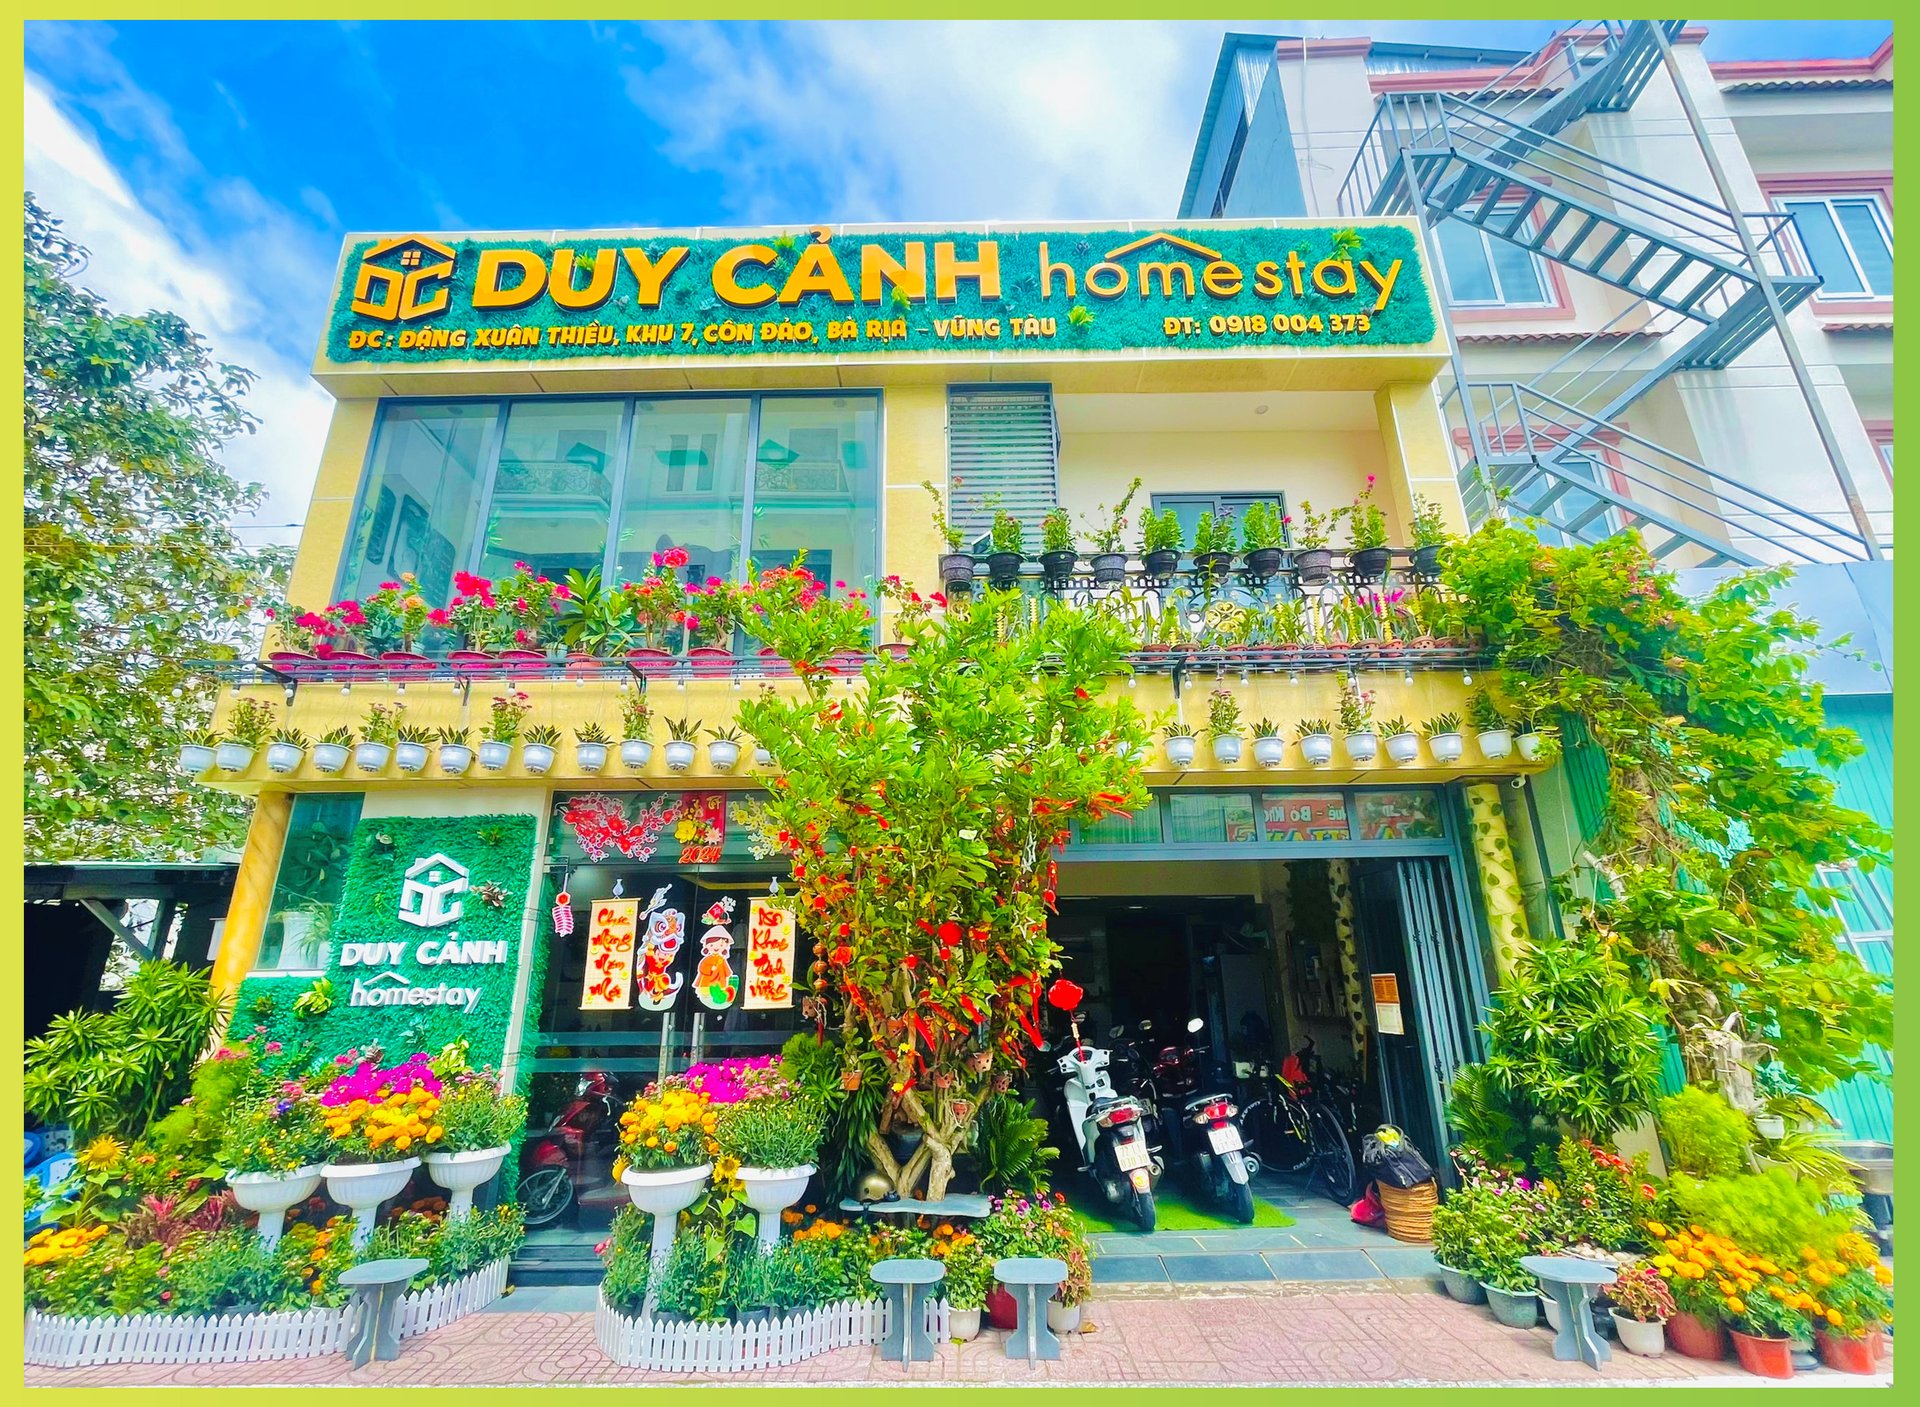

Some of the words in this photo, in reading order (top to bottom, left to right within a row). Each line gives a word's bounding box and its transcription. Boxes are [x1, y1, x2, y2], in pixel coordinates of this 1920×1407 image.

[472, 246, 690, 311] DUY
[712, 227, 1000, 308] CẢNH
[1039, 237, 1403, 313] homestay
[399, 325, 467, 350] ĐẶNG
[473, 323, 540, 348] XUÂN
[547, 318, 620, 347] THIỀU,
[626, 323, 674, 344] KHU
[680, 322, 699, 348] 7,
[703, 318, 755, 344] CÔN
[760, 316, 819, 345] ĐẢO,
[827, 315, 858, 342] BÀ
[866, 317, 906, 343] RỊA
[933, 314, 1000, 340] VŨNG
[1009, 313, 1057, 339] TÀU
[1163, 316, 1201, 336] ĐT:
[1209, 315, 1268, 335] 0918
[1272, 314, 1324, 335] 004
[1329, 314, 1371, 333] 373
[678, 846, 722, 865] 2024
[339, 942, 408, 967] DUY
[415, 932, 509, 966] CẢNH
[349, 976, 483, 1014] homestay
